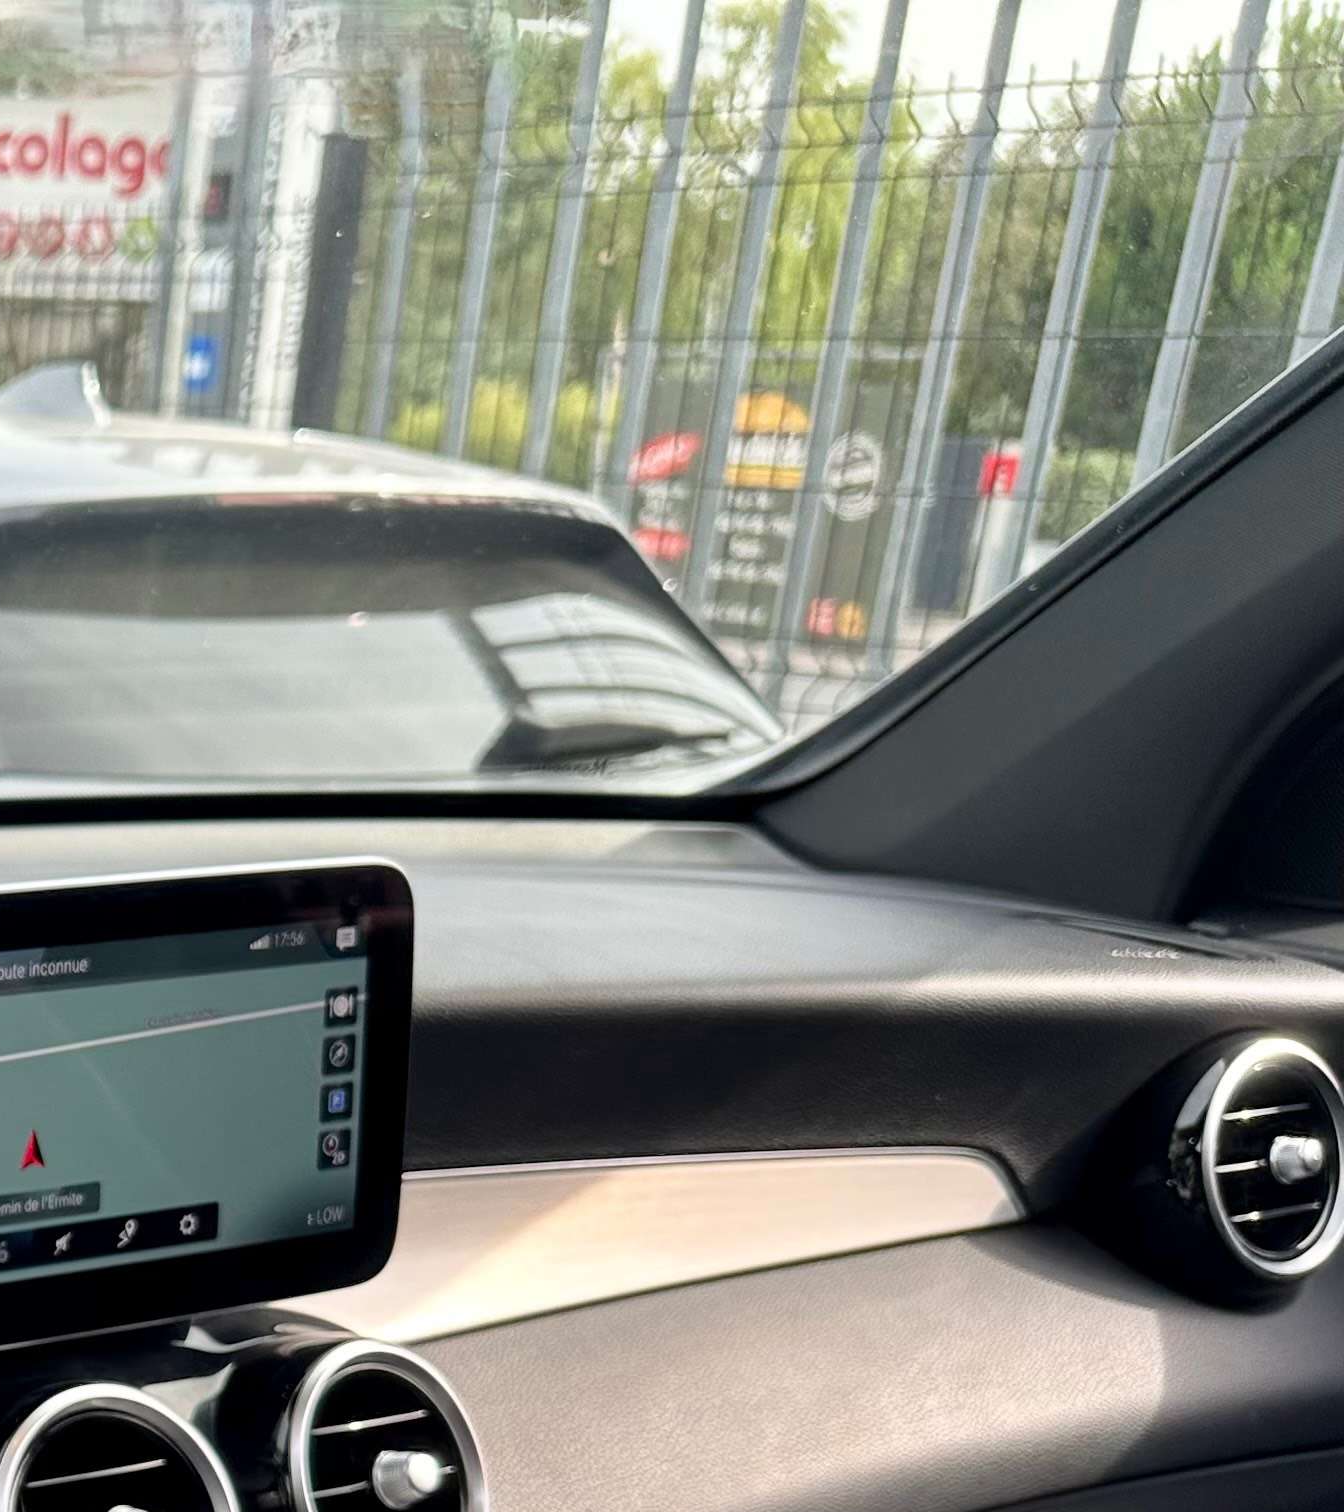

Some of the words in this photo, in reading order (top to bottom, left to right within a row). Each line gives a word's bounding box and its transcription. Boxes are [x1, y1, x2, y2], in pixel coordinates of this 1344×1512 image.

[29, 957, 89, 978] inconnue
[24, 1198, 40, 1213] de
[41, 1192, 84, 1210] l'Ermite
[316, 1205, 345, 1225] LOW
